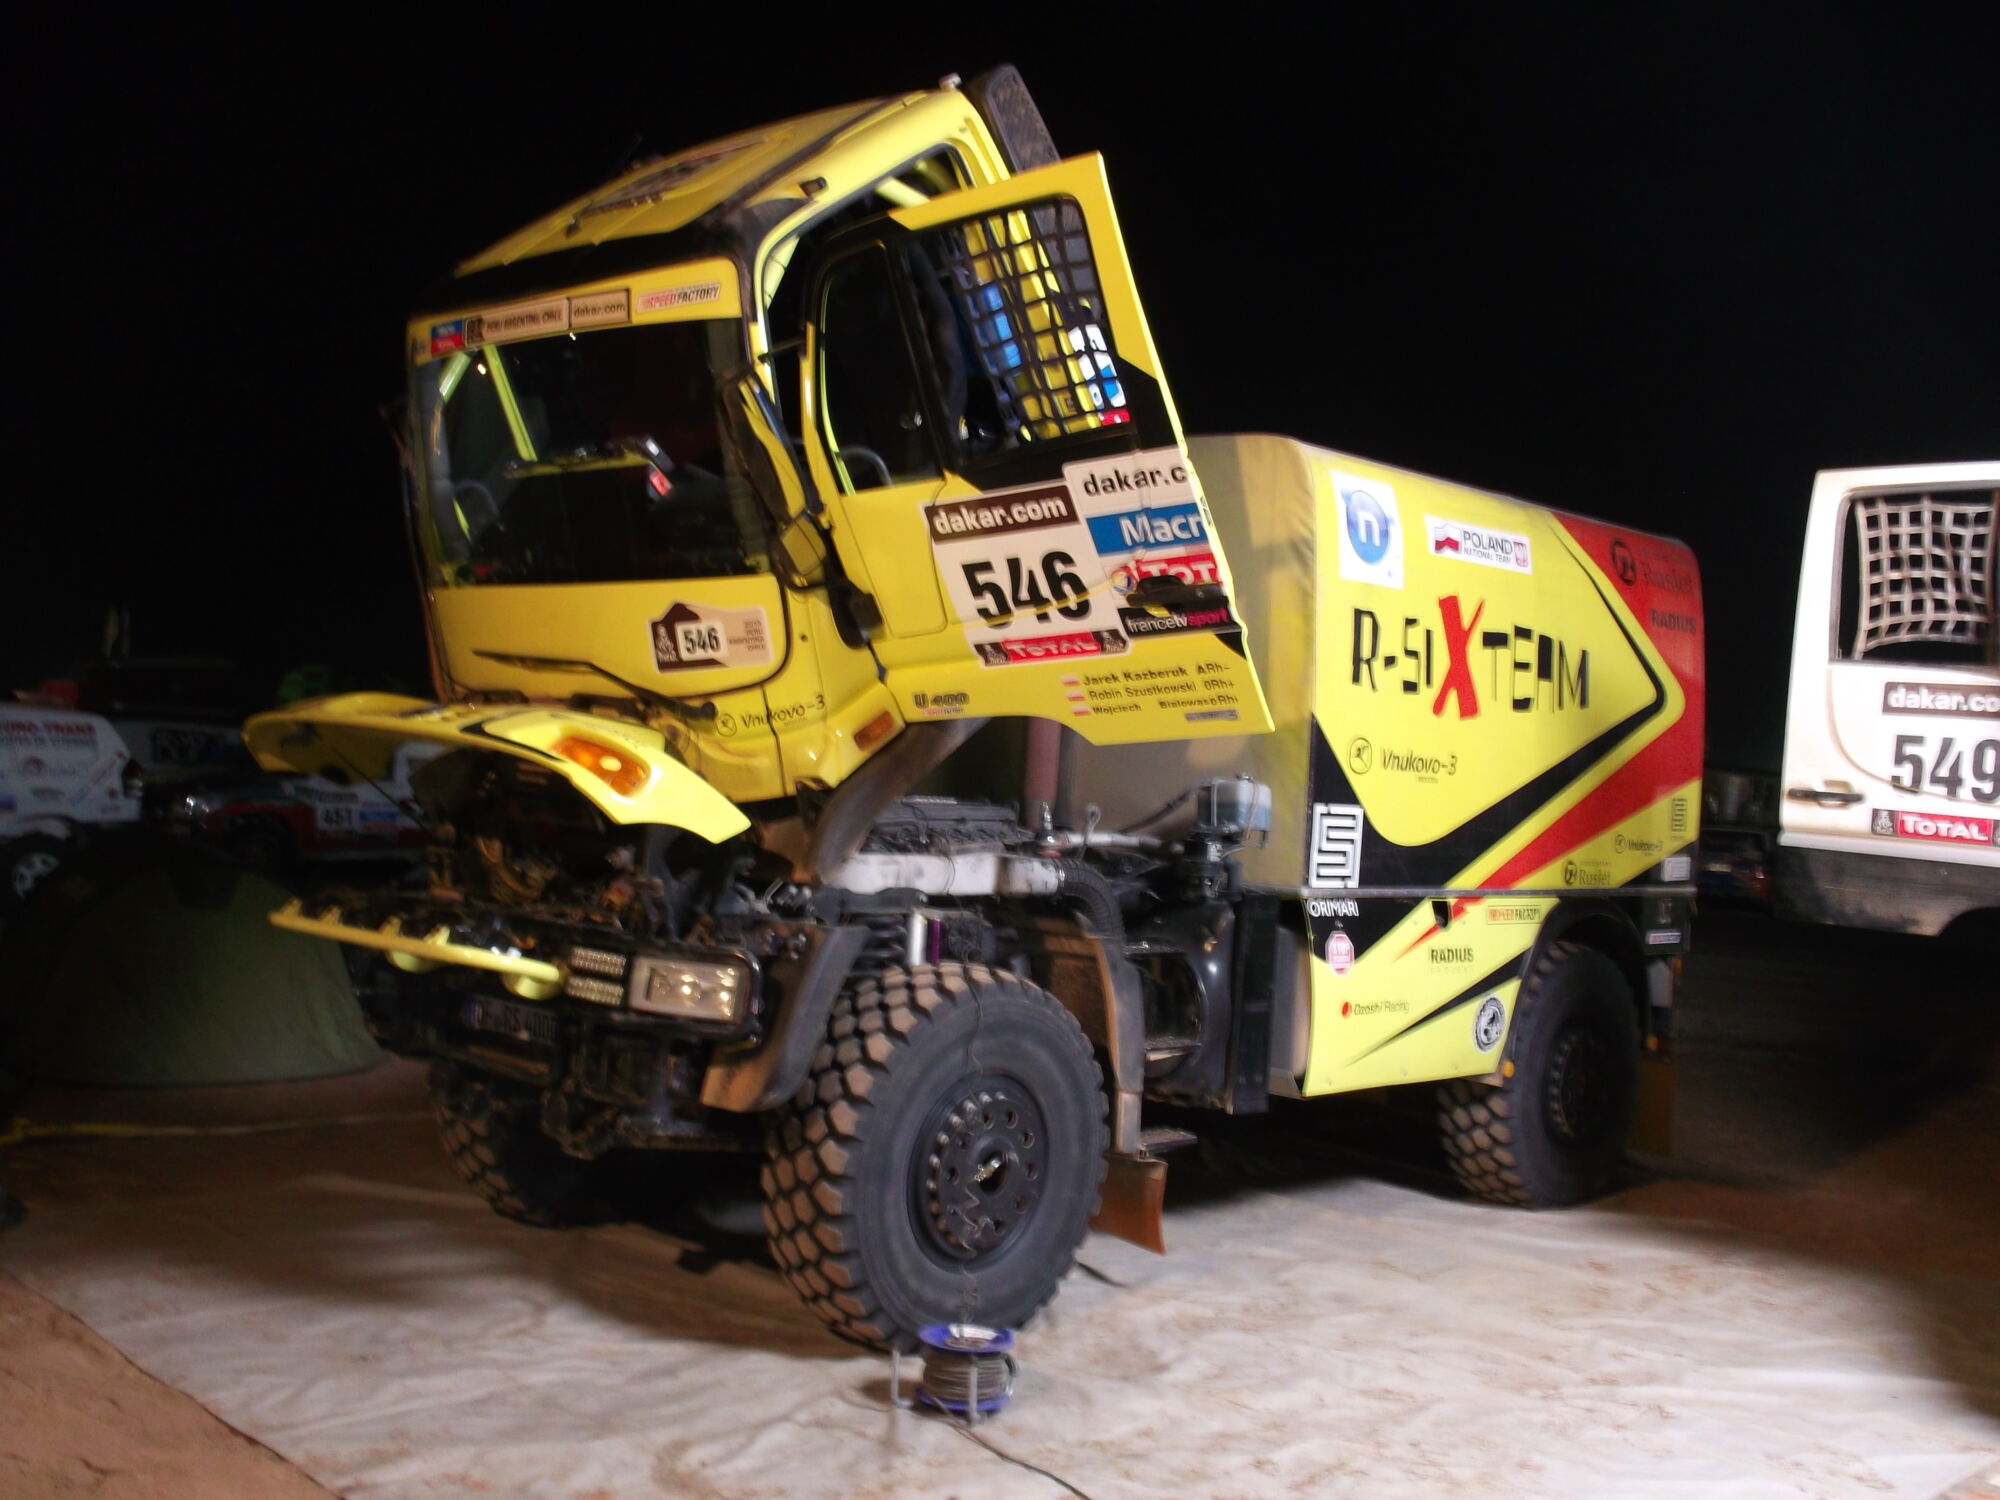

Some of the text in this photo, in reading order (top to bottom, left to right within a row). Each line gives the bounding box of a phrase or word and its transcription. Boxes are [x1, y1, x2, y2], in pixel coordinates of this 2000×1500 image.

[573, 302, 625, 318] dakar.com
[933, 495, 1068, 536] dakar.com
[1463, 530, 1513, 555] POLAND
[1463, 548, 1512, 563] NATIONAL TEAM
[962, 549, 1090, 628] 546
[1651, 610, 1697, 633] RADIUS
[683, 627, 720, 654] 546
[1005, 639, 1098, 659] TOTAL
[1083, 673, 1120, 687] Jarek
[1123, 667, 1188, 682] Kazberuk
[1089, 688, 1123, 702] Robin
[1125, 681, 1197, 698] Szustkowski
[741, 694, 825, 729] Vnukovo-3
[1092, 703, 1142, 716] Wojciech
[1382, 747, 1458, 776] Vnukovo-3
[1891, 734, 2000, 804] 549
[1901, 815, 1989, 841] TOTAL
[1431, 948, 1474, 964] RADIUS
